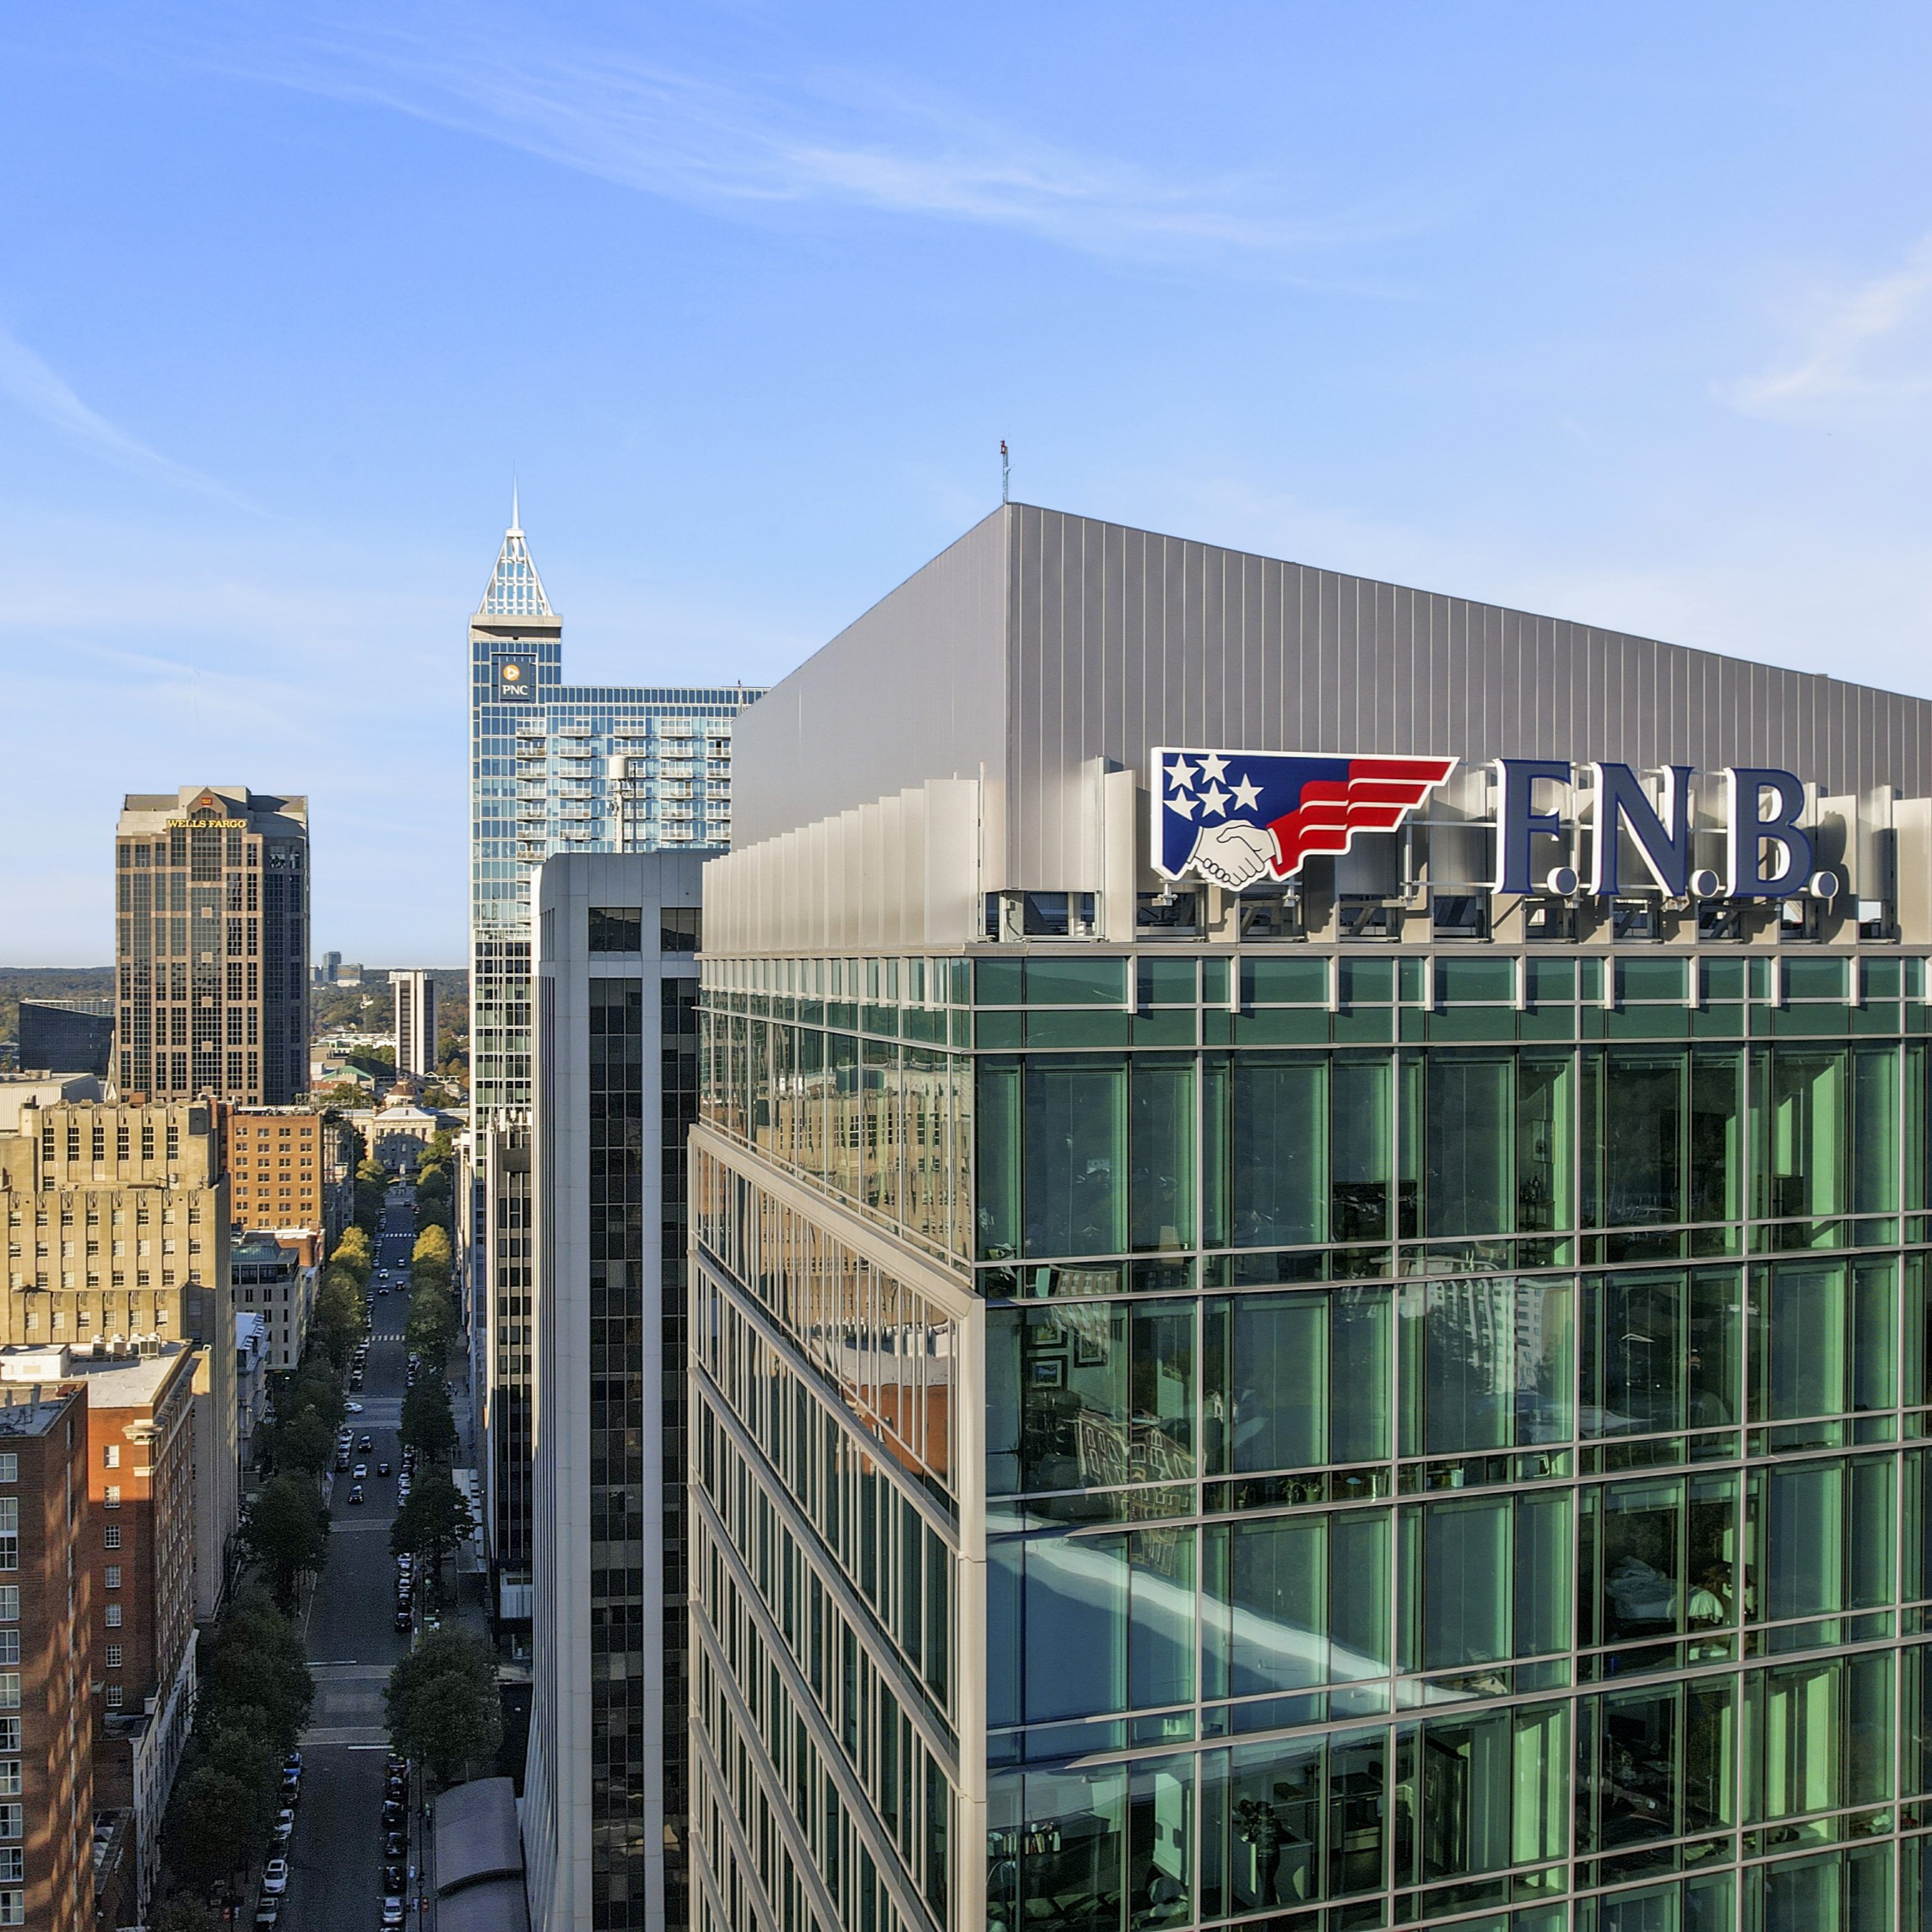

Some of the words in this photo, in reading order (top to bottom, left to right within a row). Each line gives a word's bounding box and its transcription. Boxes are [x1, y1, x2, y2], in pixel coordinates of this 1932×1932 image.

[501, 685, 528, 695] PNC
[167, 820, 207, 828] WELLS
[208, 820, 246, 828] FARGO
[1491, 758, 1839, 898] F.N.B.
